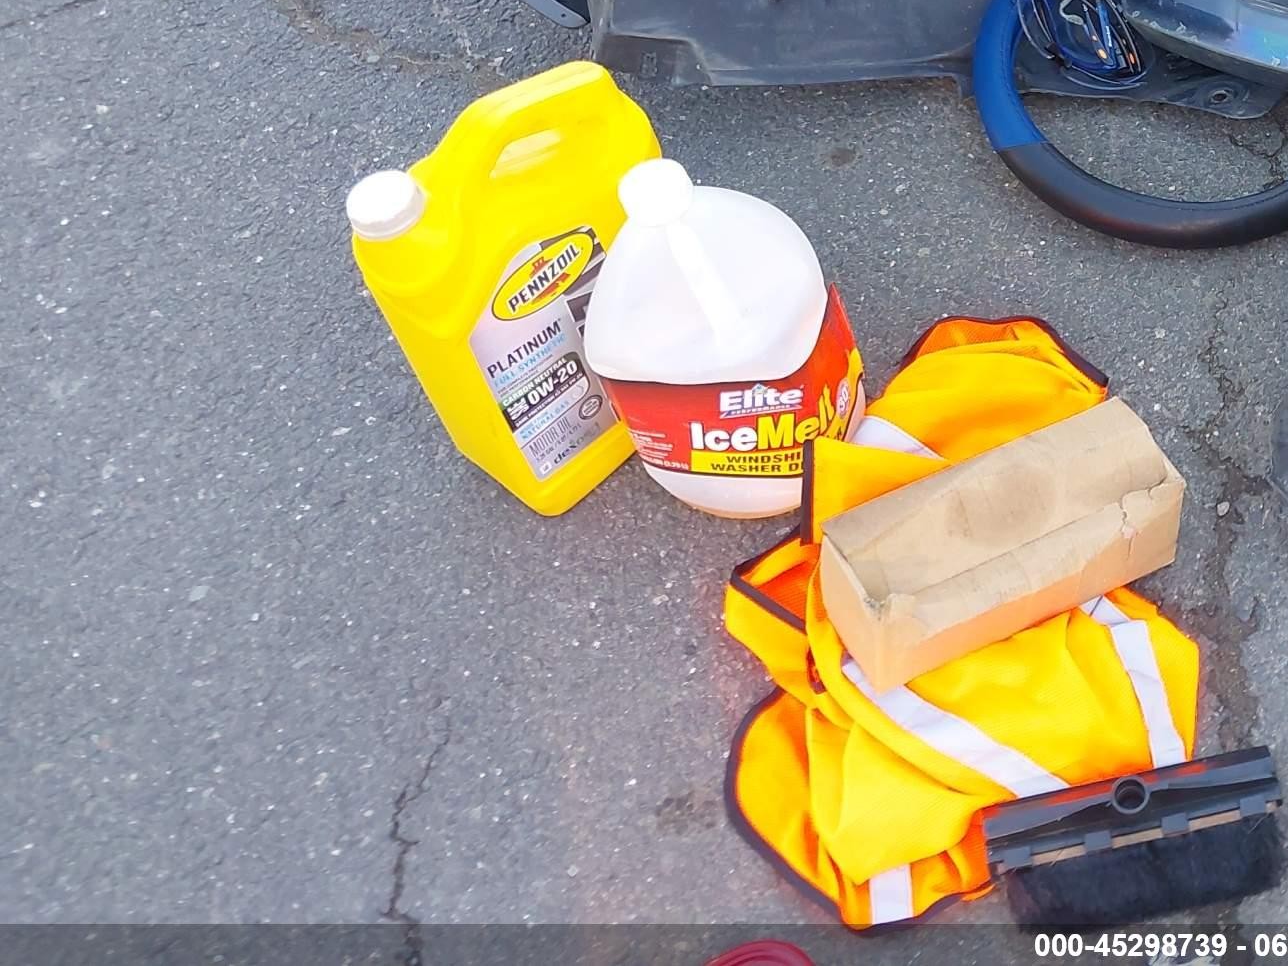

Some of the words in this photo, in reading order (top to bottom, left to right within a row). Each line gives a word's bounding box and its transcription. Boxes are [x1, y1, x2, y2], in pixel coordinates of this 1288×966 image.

[508, 244, 579, 312] PENNZOIL
[487, 321, 561, 378] PLATINUM
[503, 383, 534, 407] CARBON
[533, 358, 568, 386] NEUTRAL
[527, 360, 578, 406] 0W-20
[720, 384, 804, 412] Elite
[529, 425, 558, 457] MOTOR
[557, 416, 572, 435] OIL
[726, 451, 801, 464] WINDSHI
[711, 463, 781, 472] WASHER
